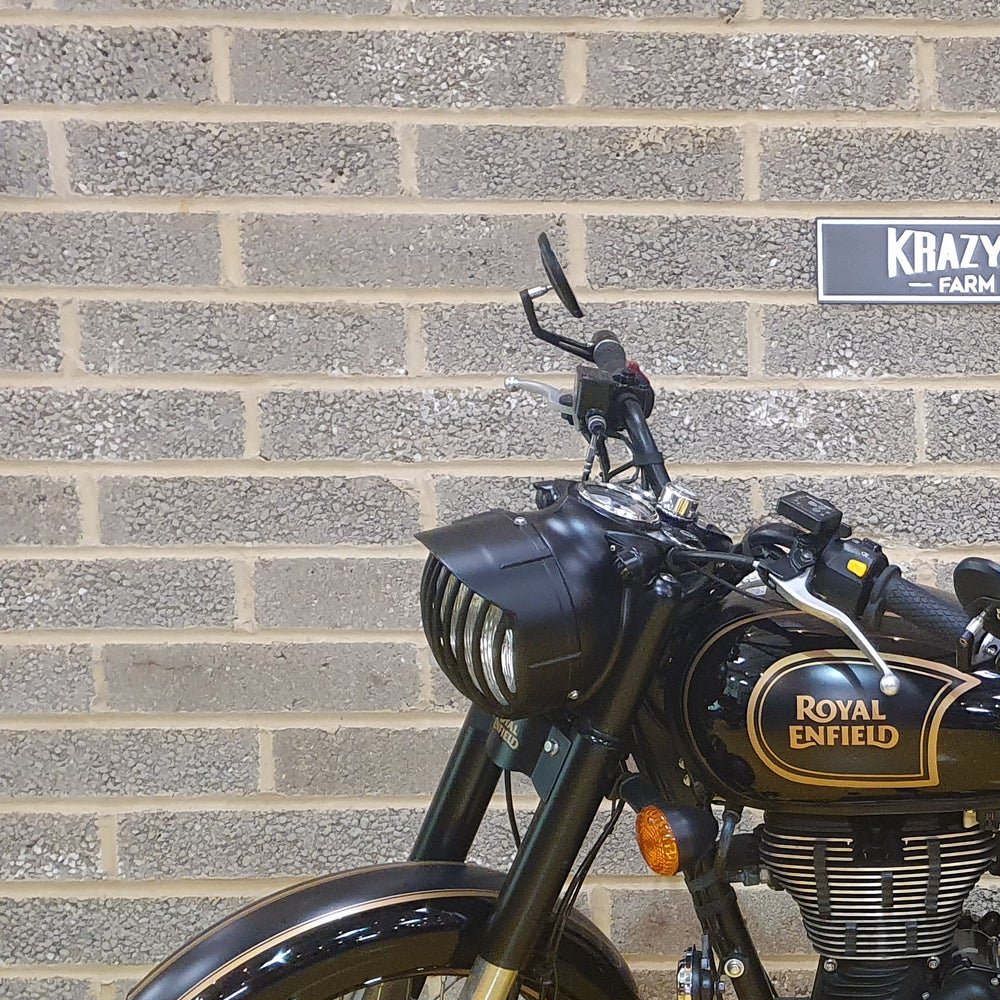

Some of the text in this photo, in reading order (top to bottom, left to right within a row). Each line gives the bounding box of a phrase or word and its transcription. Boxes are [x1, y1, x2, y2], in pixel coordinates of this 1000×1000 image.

[939, 275, 995, 293] FARM
[796, 695, 887, 723] ROYAL
[789, 725, 899, 749] ENFIELD
